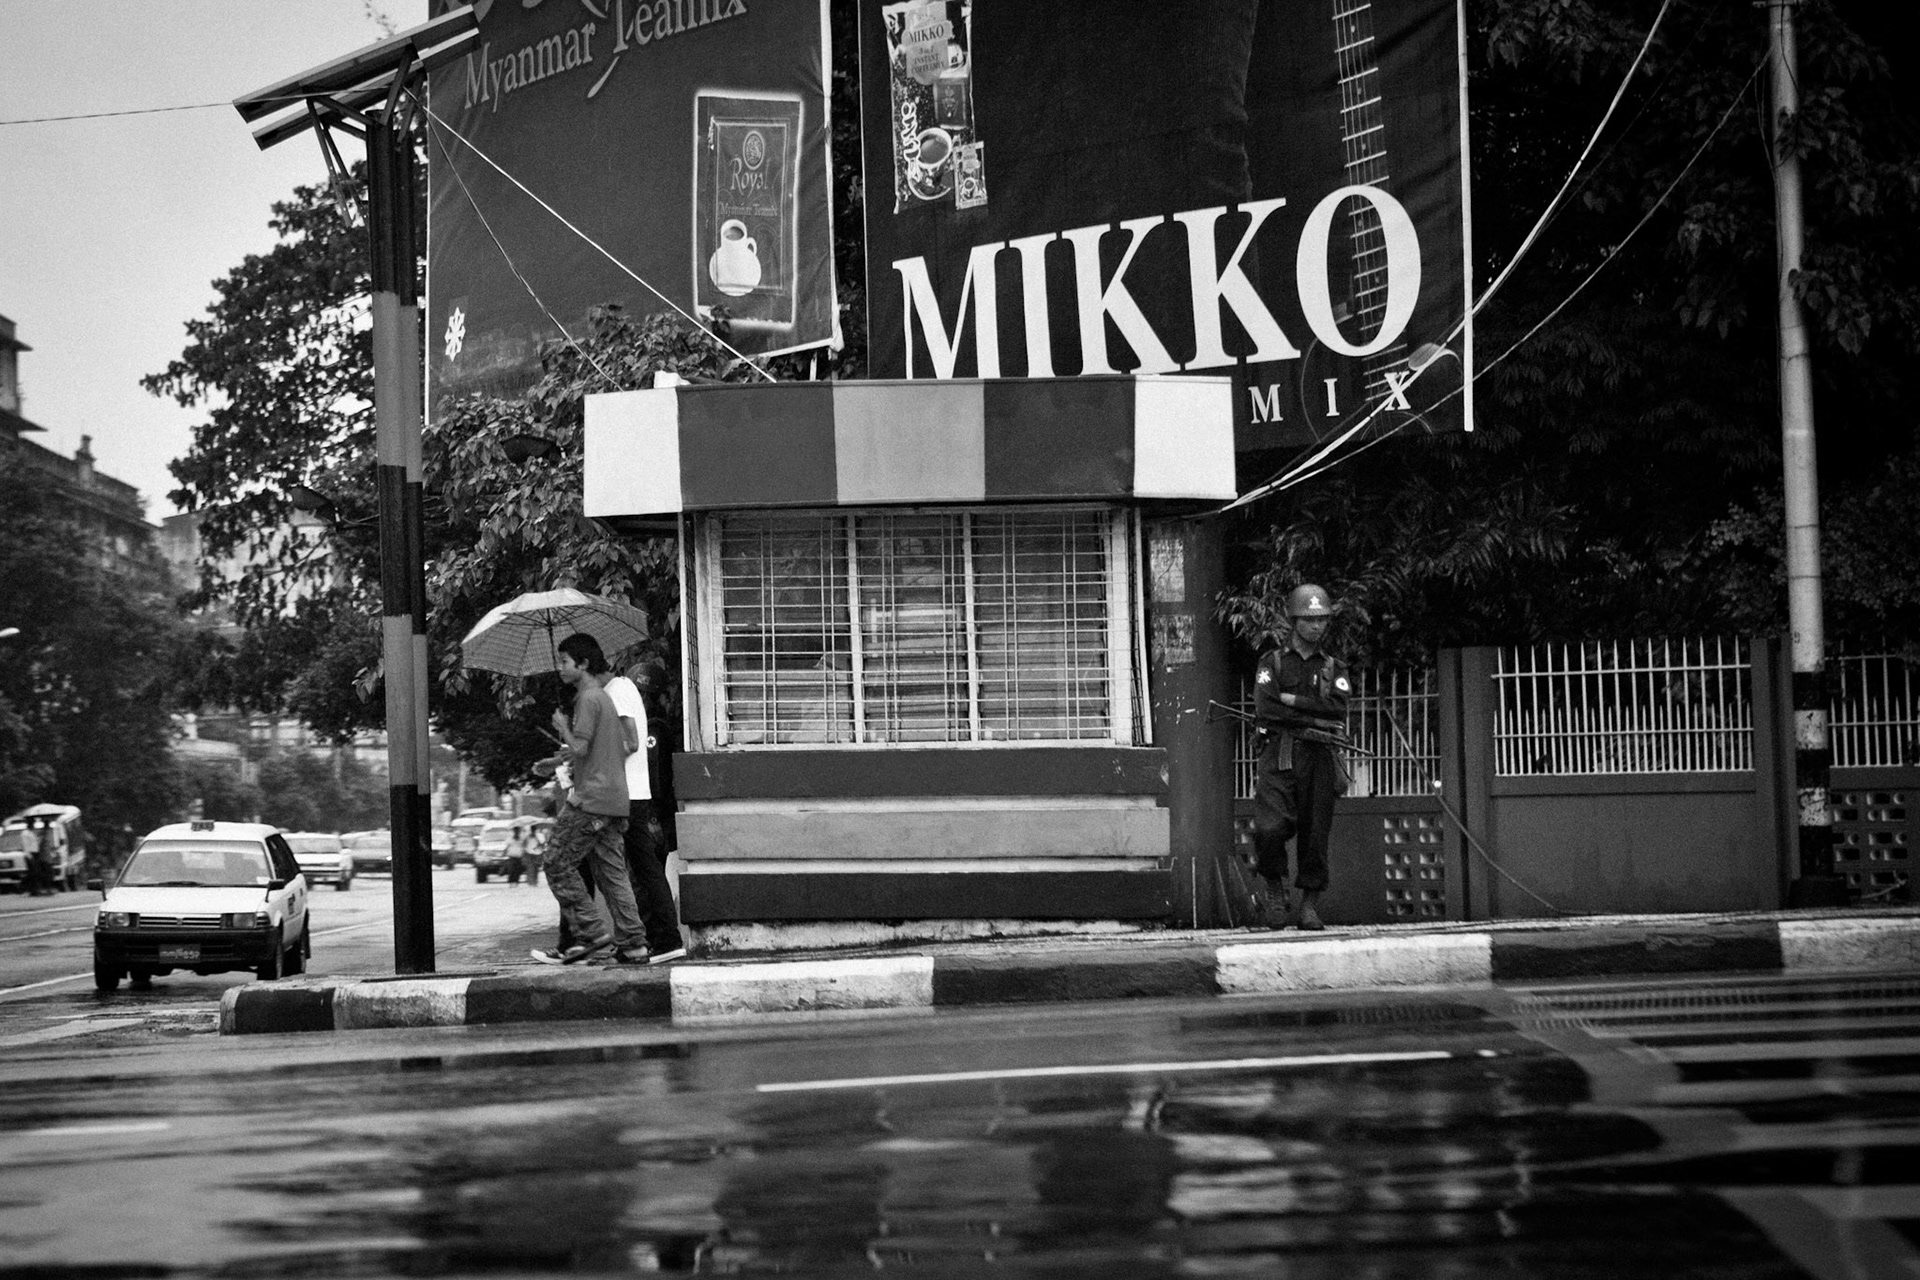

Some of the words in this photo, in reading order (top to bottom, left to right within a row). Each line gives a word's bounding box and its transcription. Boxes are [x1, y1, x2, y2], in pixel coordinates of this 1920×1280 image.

[909, 24, 944, 43] MIKKO
[464, 22, 596, 113] Myanmar
[729, 157, 771, 198] Royal
[892, 185, 1422, 379] MIKKO
